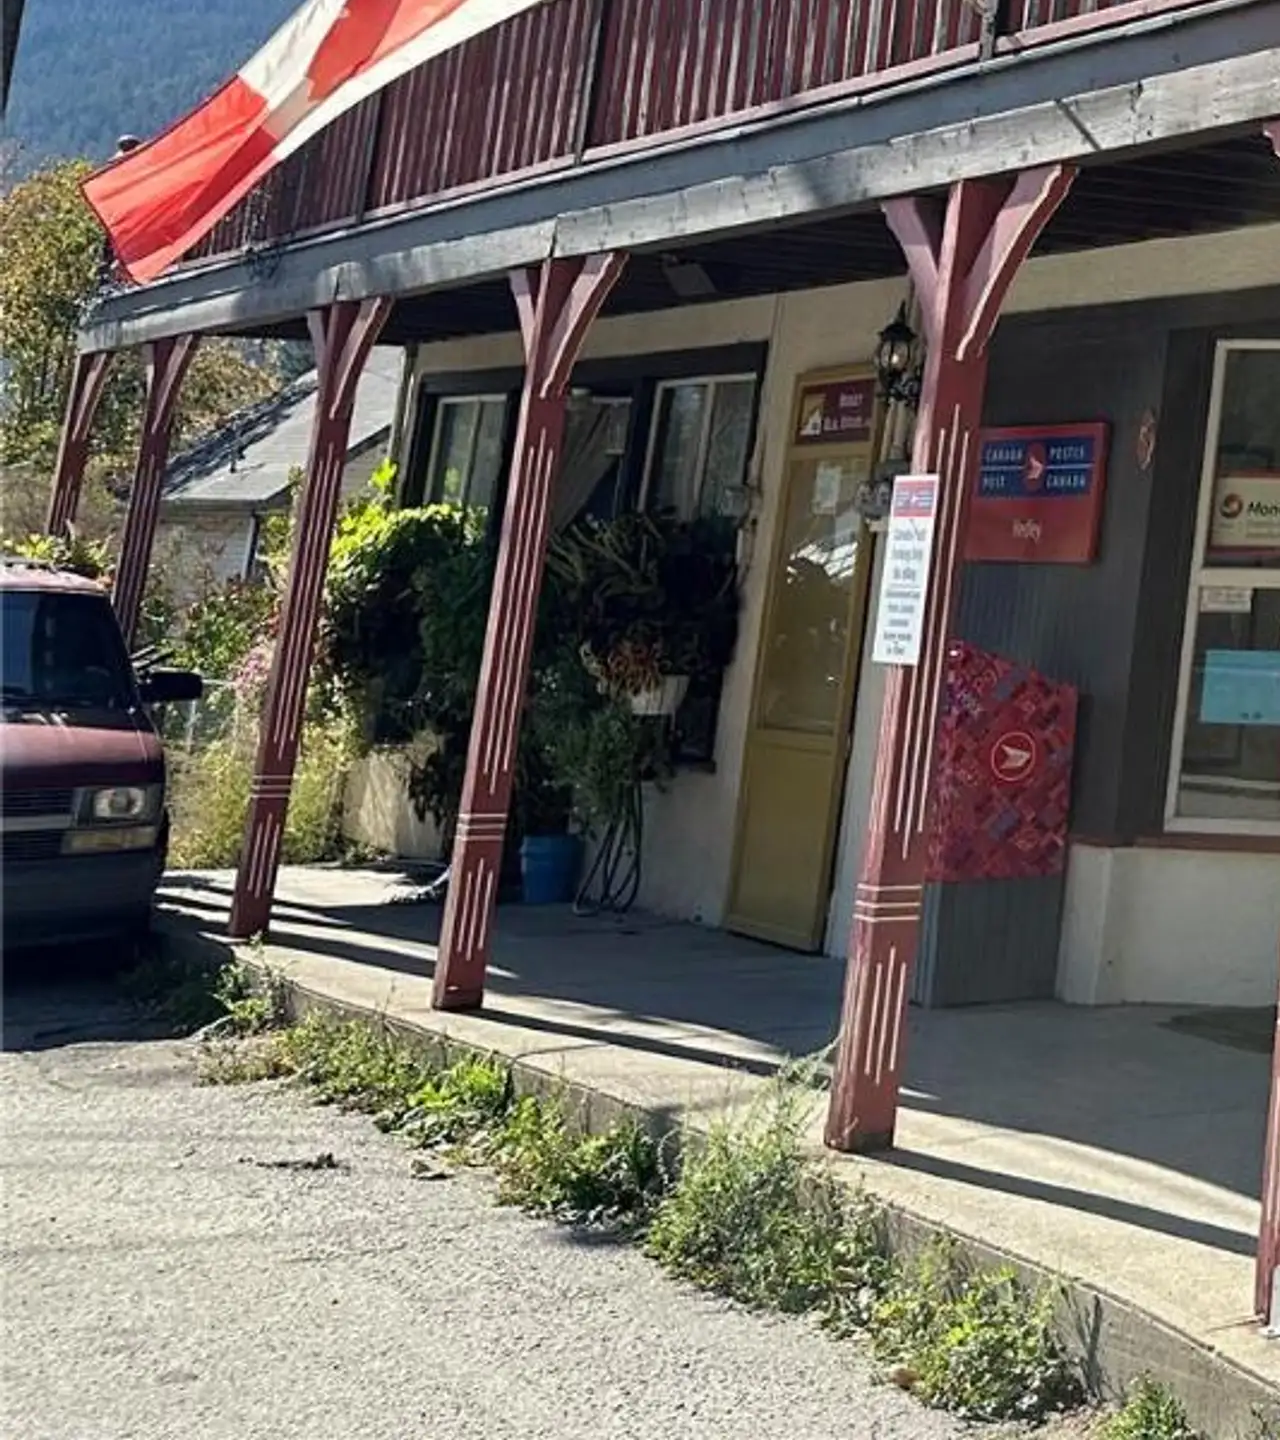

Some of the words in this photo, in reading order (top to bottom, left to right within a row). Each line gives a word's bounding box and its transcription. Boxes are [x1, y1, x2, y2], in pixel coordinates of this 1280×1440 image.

[985, 447, 1023, 463] CANADA
[1049, 444, 1085, 461] POSTES
[982, 474, 1006, 491] POST
[1046, 471, 1086, 490] CANADA
